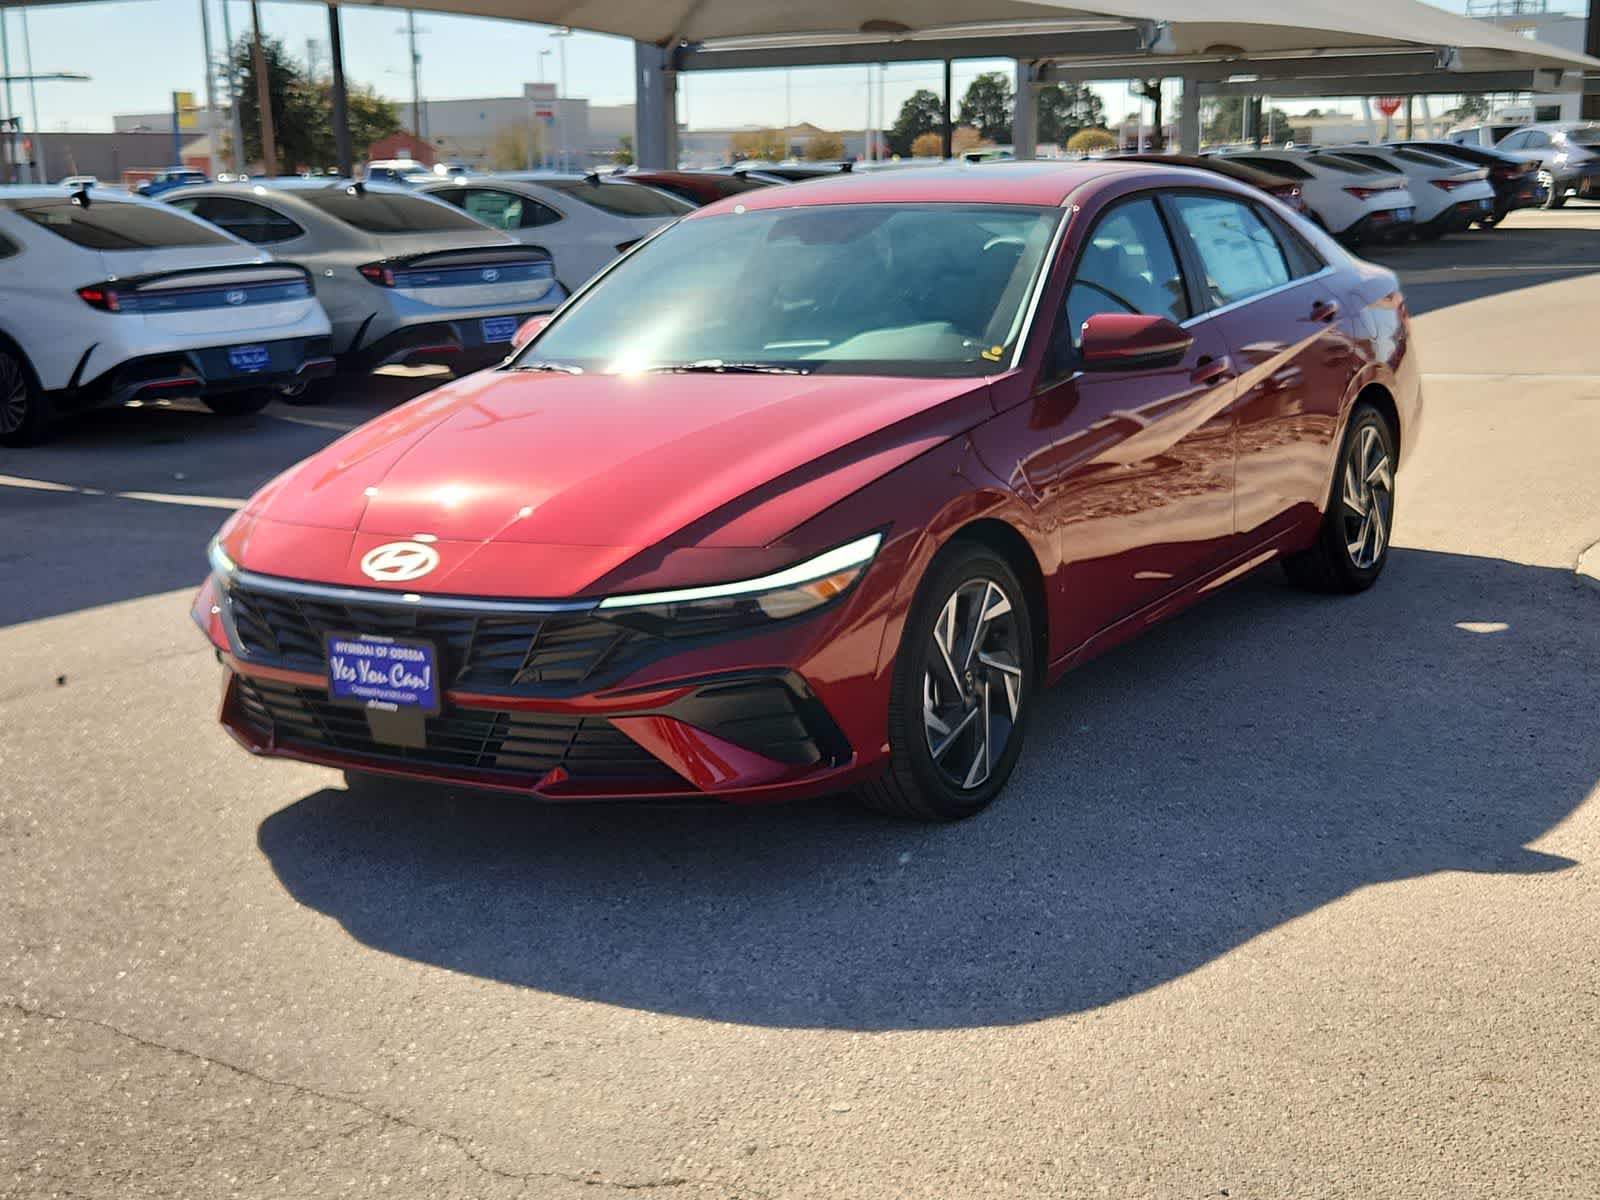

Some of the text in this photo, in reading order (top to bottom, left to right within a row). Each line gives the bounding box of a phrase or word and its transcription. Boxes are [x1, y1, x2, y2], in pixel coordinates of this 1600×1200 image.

[332, 656, 430, 690] Yes You Can!
